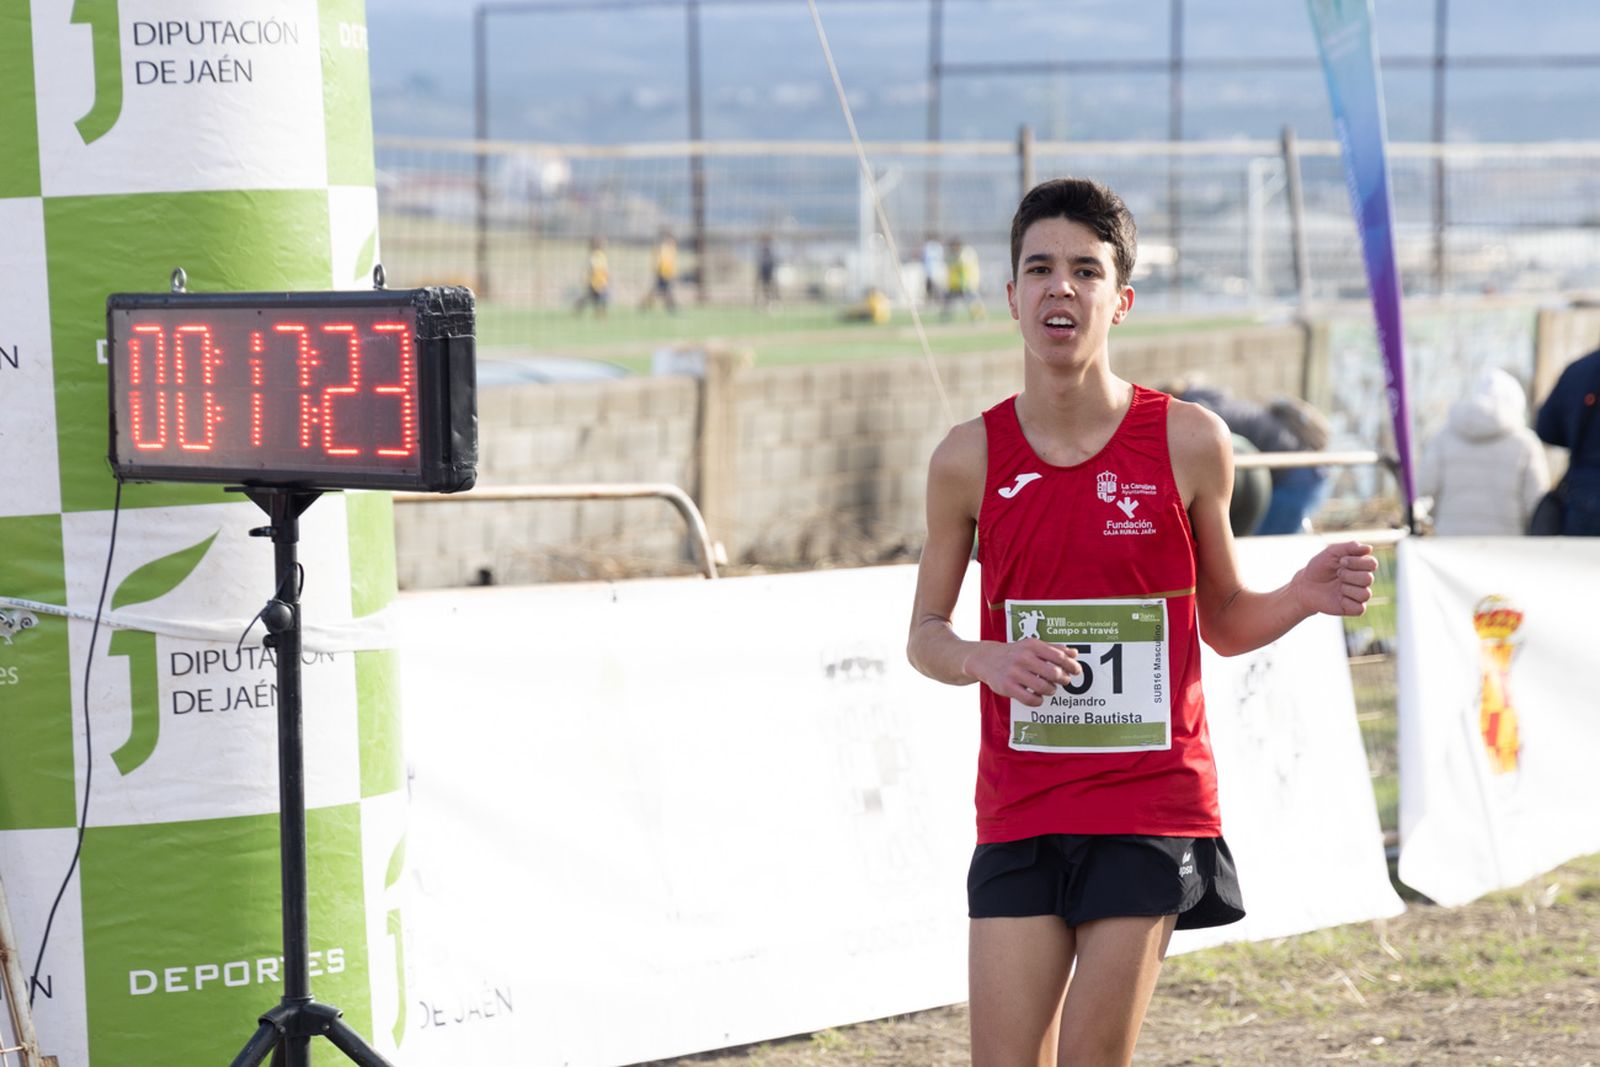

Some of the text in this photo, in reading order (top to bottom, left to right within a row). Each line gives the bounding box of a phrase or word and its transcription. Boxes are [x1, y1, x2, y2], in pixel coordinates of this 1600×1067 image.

[133, 16, 298, 46] DIPUTACIÓN
[135, 54, 253, 85] DE JAÉN
[128, 325, 417, 456] 00:17:23
[1106, 519, 1153, 529] Fundación
[1046, 627, 1080, 636] Campo
[1090, 627, 1120, 635] través
[1153, 624, 1163, 704] SUB16 Masculino
[172, 687, 214, 715] DE
[1050, 696, 1106, 708] Alejandro
[1031, 711, 1142, 724] Donaire Bautista
[129, 948, 345, 996] DEPORES
